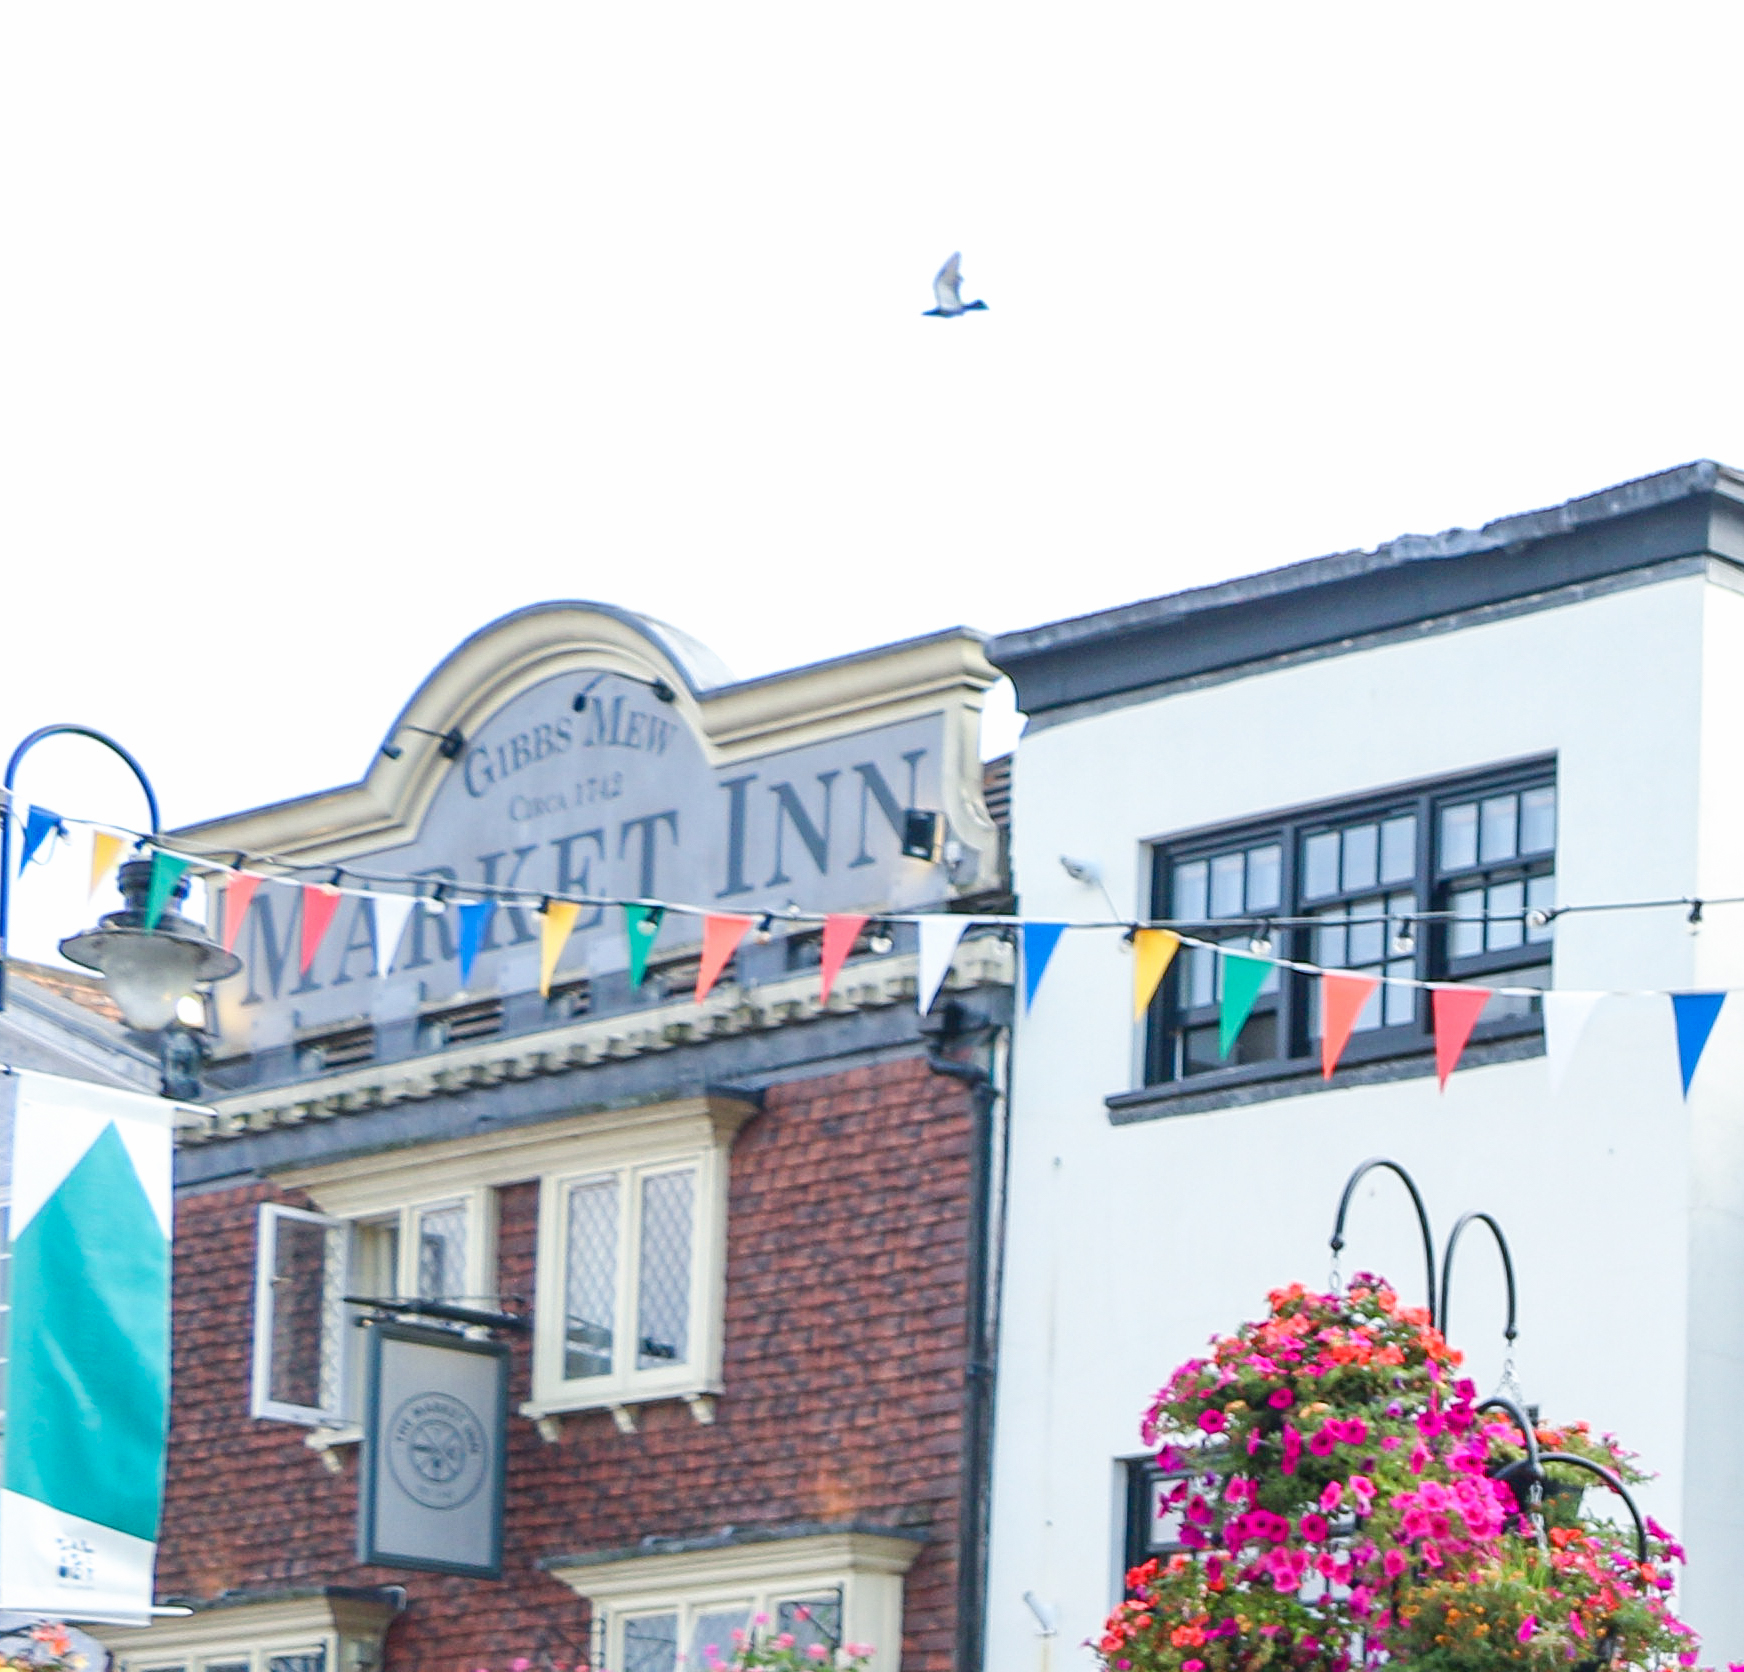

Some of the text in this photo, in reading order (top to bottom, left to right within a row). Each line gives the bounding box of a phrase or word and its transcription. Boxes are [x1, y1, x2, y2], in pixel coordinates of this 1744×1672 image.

[464, 696, 679, 798] GIBBS MEW
[240, 748, 928, 1006] MARKET INN
